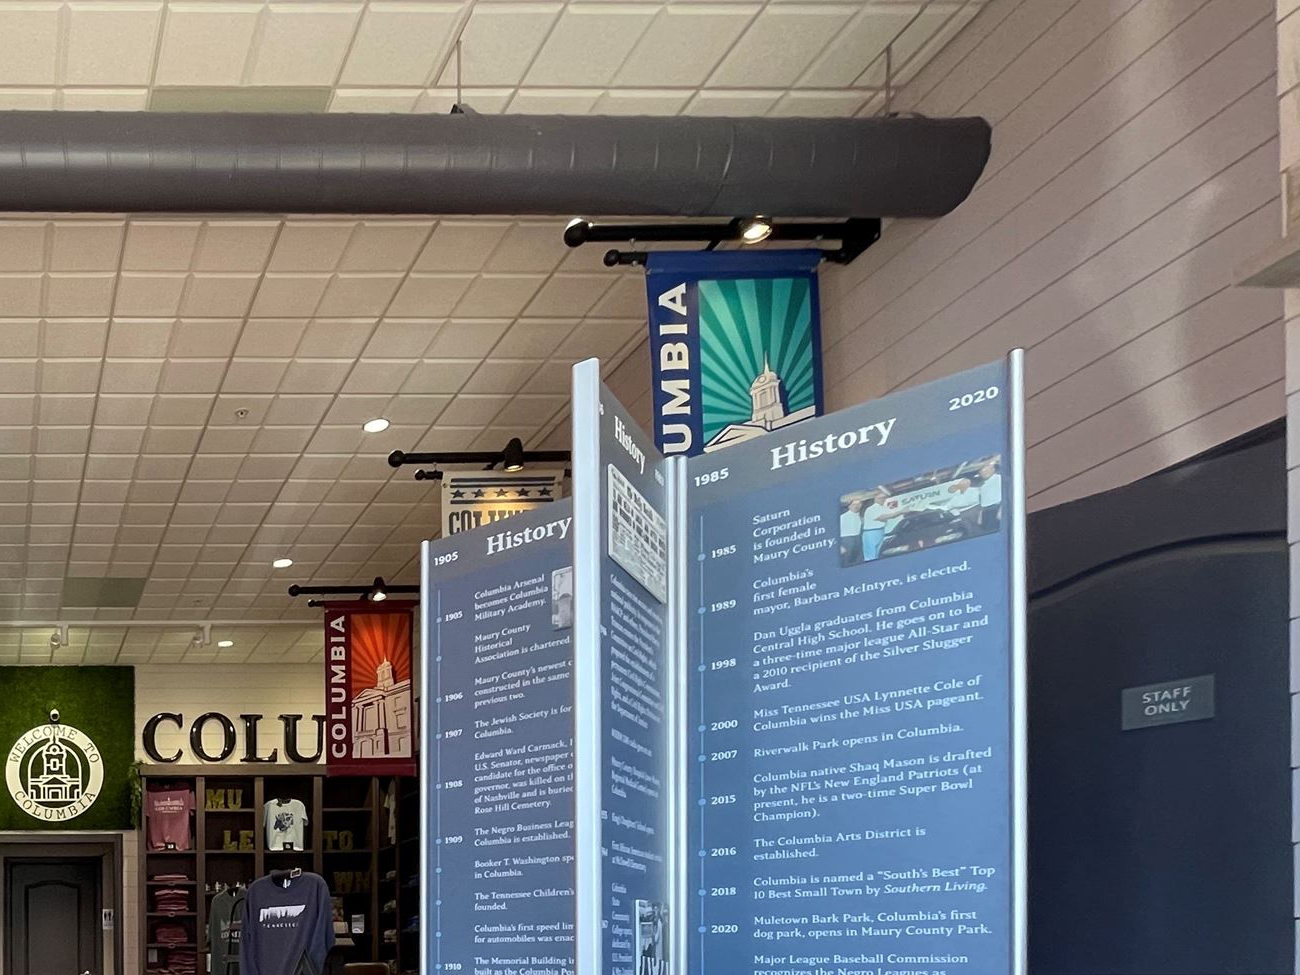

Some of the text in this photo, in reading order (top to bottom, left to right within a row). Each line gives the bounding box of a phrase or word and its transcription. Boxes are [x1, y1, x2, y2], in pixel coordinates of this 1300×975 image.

[948, 386, 999, 412] 2020
[614, 415, 646, 474] History
[770, 417, 897, 471] History
[694, 467, 729, 487] 1985
[752, 509, 790, 525] Saturn
[753, 515, 820, 537] Corporation
[486, 517, 573, 555] History
[753, 527, 825, 550] is founded in
[712, 544, 736, 558] 1985
[753, 538, 834, 563] Maury County.
[434, 551, 459, 567] 1905
[474, 573, 544, 599] Columbia Arsenal
[474, 598, 546, 621] Military Academy.
[711, 599, 736, 612] 1989
[445, 610, 462, 621] 1905
[474, 649, 519, 664] Association
[712, 658, 736, 670] 1998
[330, 615, 347, 759] COLUMBIA
[1142, 685, 1192, 704] STAFF
[445, 692, 463, 702] 1906
[1144, 700, 1190, 716] ONLY
[711, 719, 738, 731] 2000
[142, 712, 327, 763] COLU
[445, 729, 462, 738] 1907
[754, 723, 963, 757] Riverwalk Park opens in Columbia.
[9, 725, 100, 764] WELCOME TO
[711, 749, 737, 761] 2007
[14, 790, 96, 819] COLUMBIA
[474, 800, 551, 814] Rose Hill Cemetery.
[711, 794, 736, 805] 2015
[222, 830, 254, 850] LE
[445, 835, 463, 844] 1909
[474, 836, 511, 846] Columbia
[521, 830, 569, 842] established.
[711, 847, 736, 856] 2016
[753, 875, 806, 886] Columbia
[810, 875, 819, 883] is
[823, 871, 863, 883] named
[969, 866, 995, 877] Top
[711, 887, 736, 896] 2018
[754, 881, 987, 899] 10 Best Small Town by Southern Living.
[754, 909, 976, 925] Muletown Bark Park, Columbia's first
[711, 924, 738, 933] 2020
[753, 928, 773, 940] dog
[776, 927, 805, 940] park,
[807, 930, 842, 939] opens
[861, 926, 902, 938] Maury
[905, 925, 953, 936] County
[958, 923, 991, 934] Park.
[754, 953, 968, 966] Major League Baseball Commission
